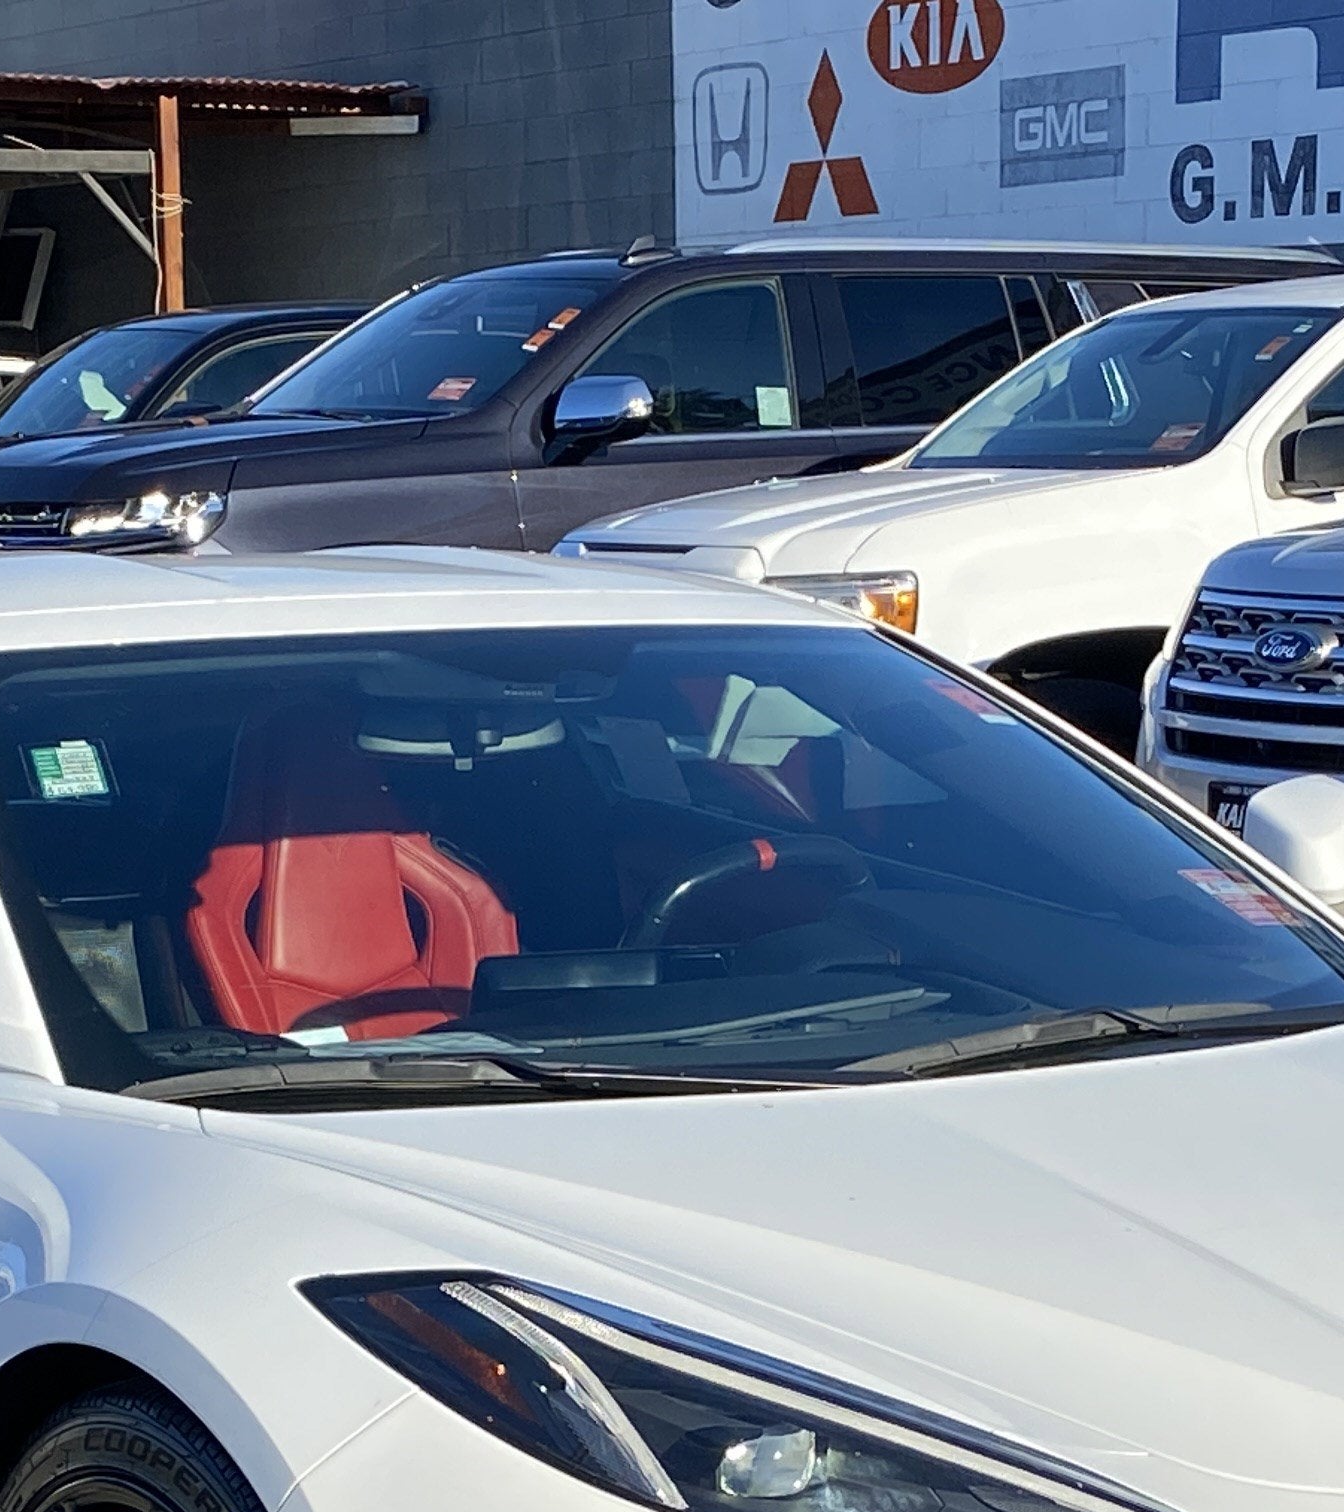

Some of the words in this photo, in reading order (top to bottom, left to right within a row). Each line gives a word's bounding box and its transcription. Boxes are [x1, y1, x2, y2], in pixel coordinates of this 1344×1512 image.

[886, 0, 985, 71] KIA
[1013, 98, 1109, 153] GMC
[1169, 133, 1342, 224] G.M.
[1261, 633, 1302, 659] Ford
